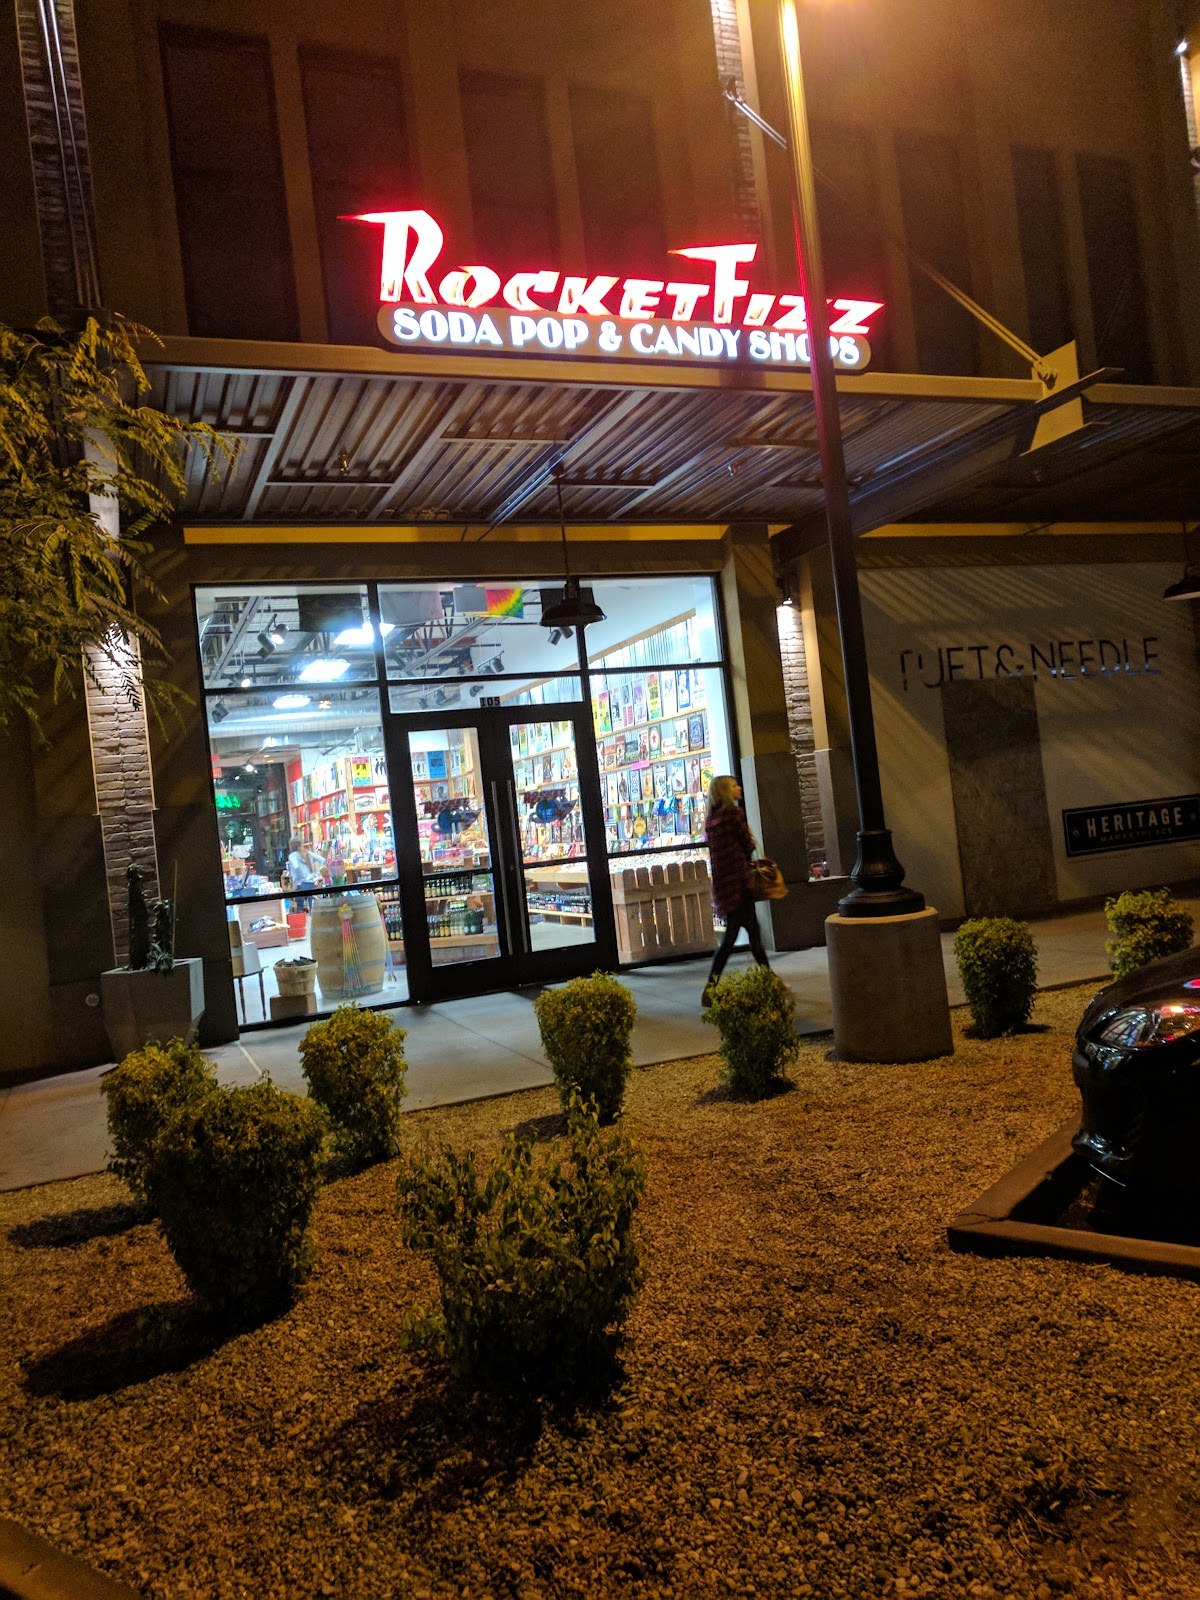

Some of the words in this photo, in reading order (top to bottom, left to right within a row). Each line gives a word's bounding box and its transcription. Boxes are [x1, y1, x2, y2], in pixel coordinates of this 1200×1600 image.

[392, 308, 503, 346] SODA
[508, 317, 589, 352] POP
[600, 322, 622, 352] &
[631, 323, 742, 362] CANDY
[1086, 806, 1184, 838] HERITAGE
